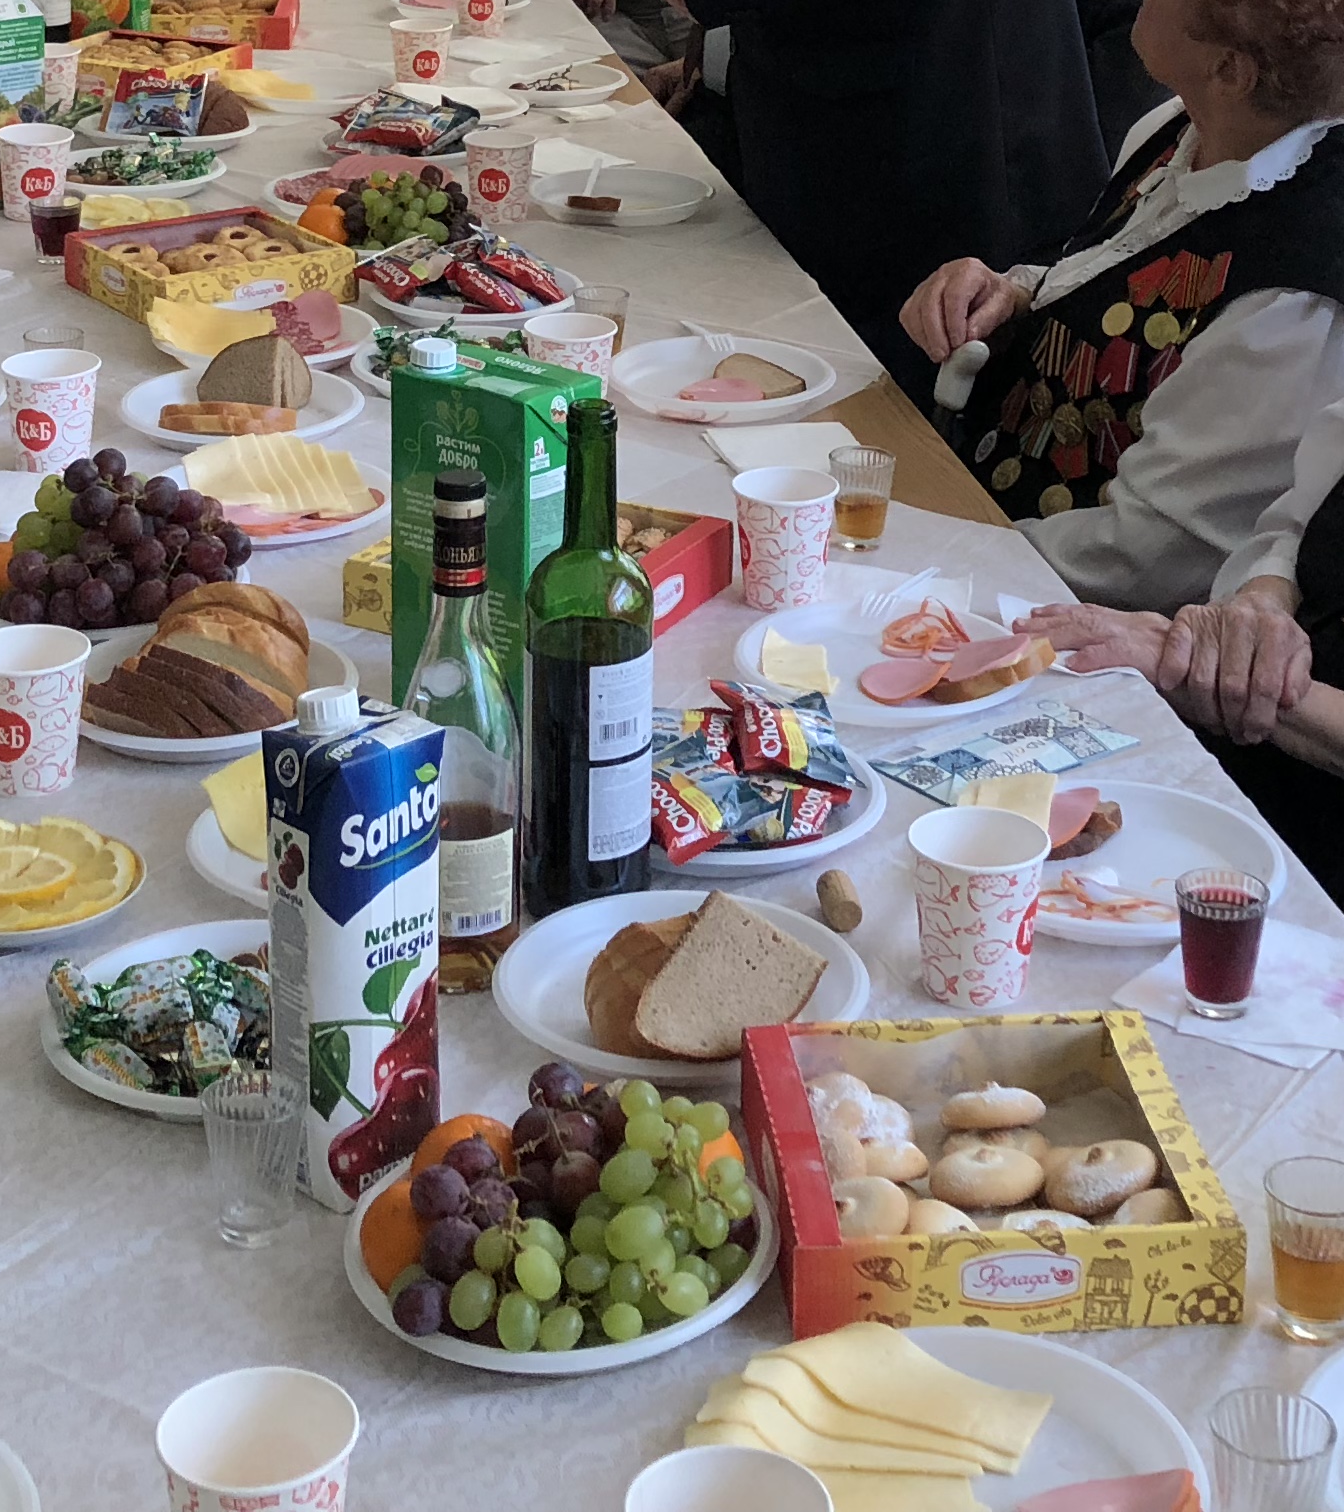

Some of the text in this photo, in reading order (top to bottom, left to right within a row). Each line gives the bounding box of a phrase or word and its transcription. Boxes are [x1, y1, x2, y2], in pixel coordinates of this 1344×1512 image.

[24, 175, 53, 192] К&Б
[18, 419, 52, 441] К&Б
[438, 449, 478, 470] ДОБРО
[340, 780, 440, 868] Santa
[366, 929, 434, 969] Ciliegia
